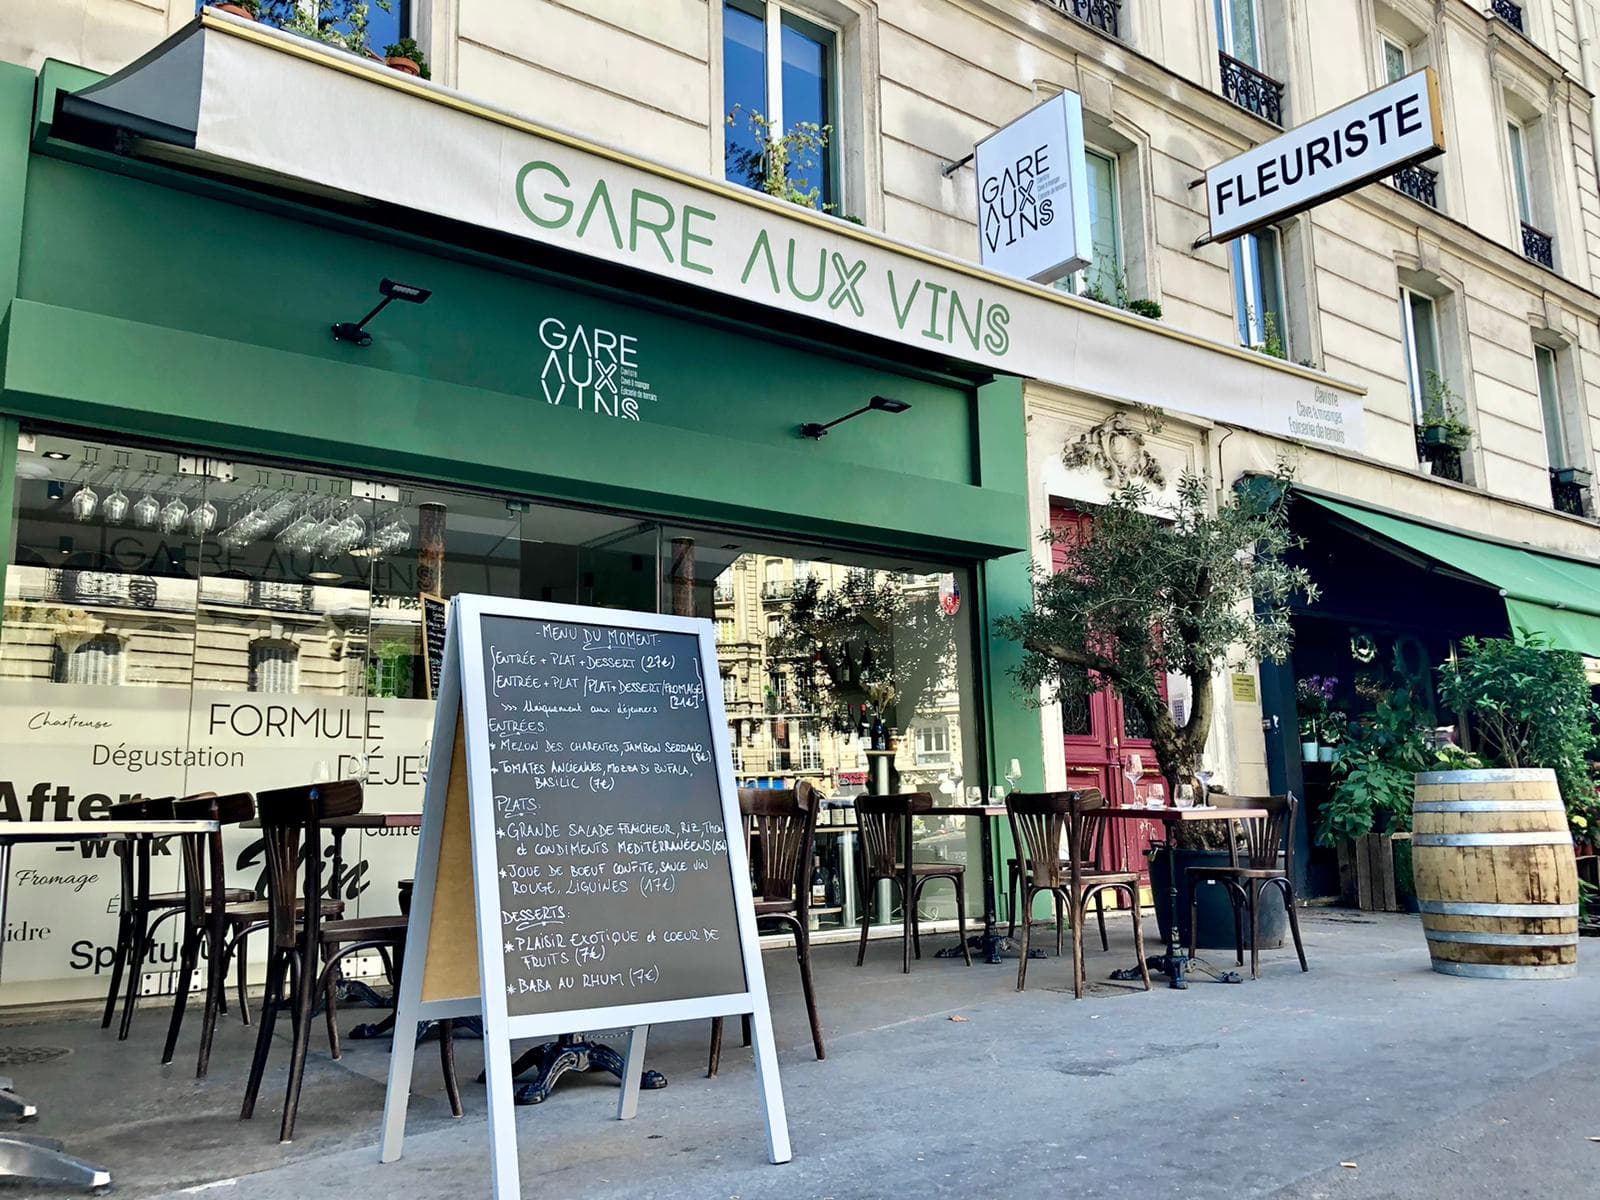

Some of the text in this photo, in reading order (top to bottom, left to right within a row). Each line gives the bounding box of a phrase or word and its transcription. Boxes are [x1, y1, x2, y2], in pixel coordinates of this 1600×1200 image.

[1216, 93, 1422, 216] FLEURISTE
[982, 144, 1050, 203] GARE
[985, 179, 1036, 231] AUX
[985, 199, 1054, 253] VINS
[515, 160, 1010, 356] GARE AUX VINS
[539, 317, 638, 368] GARE
[541, 350, 617, 394] AUX
[582, 628, 601, 643] DU
[496, 650, 537, 665] ENTRÉE
[550, 652, 576, 666] PLAT
[496, 675, 541, 688] ENTRÉE
[551, 675, 579, 689] PLAT
[28, 711, 113, 731] Chartreuse
[209, 704, 385, 740] FORMULE
[92, 742, 244, 773] Dégustation
[501, 739, 539, 752] MELON
[545, 740, 564, 753] DES
[623, 741, 660, 753] JAMBON
[499, 760, 546, 775] TOMATES
[507, 822, 560, 840] GRANDE
[568, 823, 614, 838] SALADE
[534, 842, 609, 856] CONDIMENTS
[15, 870, 100, 892] Fromage
[507, 864, 541, 878] JOUE
[548, 865, 563, 877] DE
[659, 861, 688, 873] SAUCE
[640, 874, 675, 898] (17€)
[1, 921, 51, 943] idre
[515, 932, 566, 951] PLAISIR
[570, 929, 639, 946] EXOTIQUE
[703, 928, 720, 942] DE
[521, 945, 606, 970] FRUITS (7€)
[518, 964, 659, 994] BABA AU RHUM (7€)
